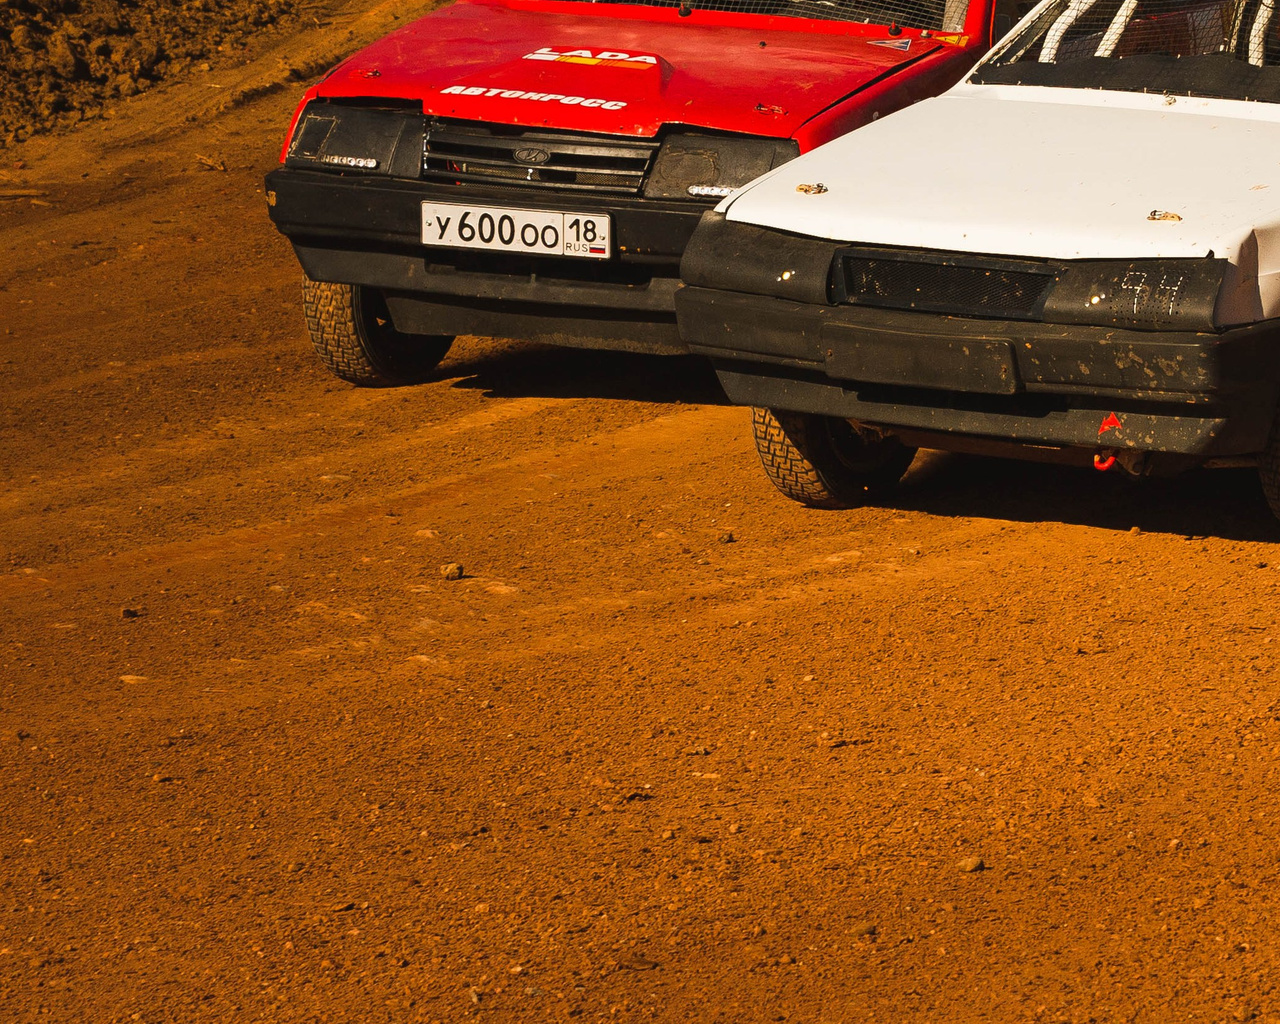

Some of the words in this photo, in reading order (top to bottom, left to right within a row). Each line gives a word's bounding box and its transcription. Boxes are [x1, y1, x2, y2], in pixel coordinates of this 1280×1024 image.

[533, 47, 658, 64] LADA
[440, 85, 628, 110] АВТОКРОСС
[565, 242, 589, 253] RUS
